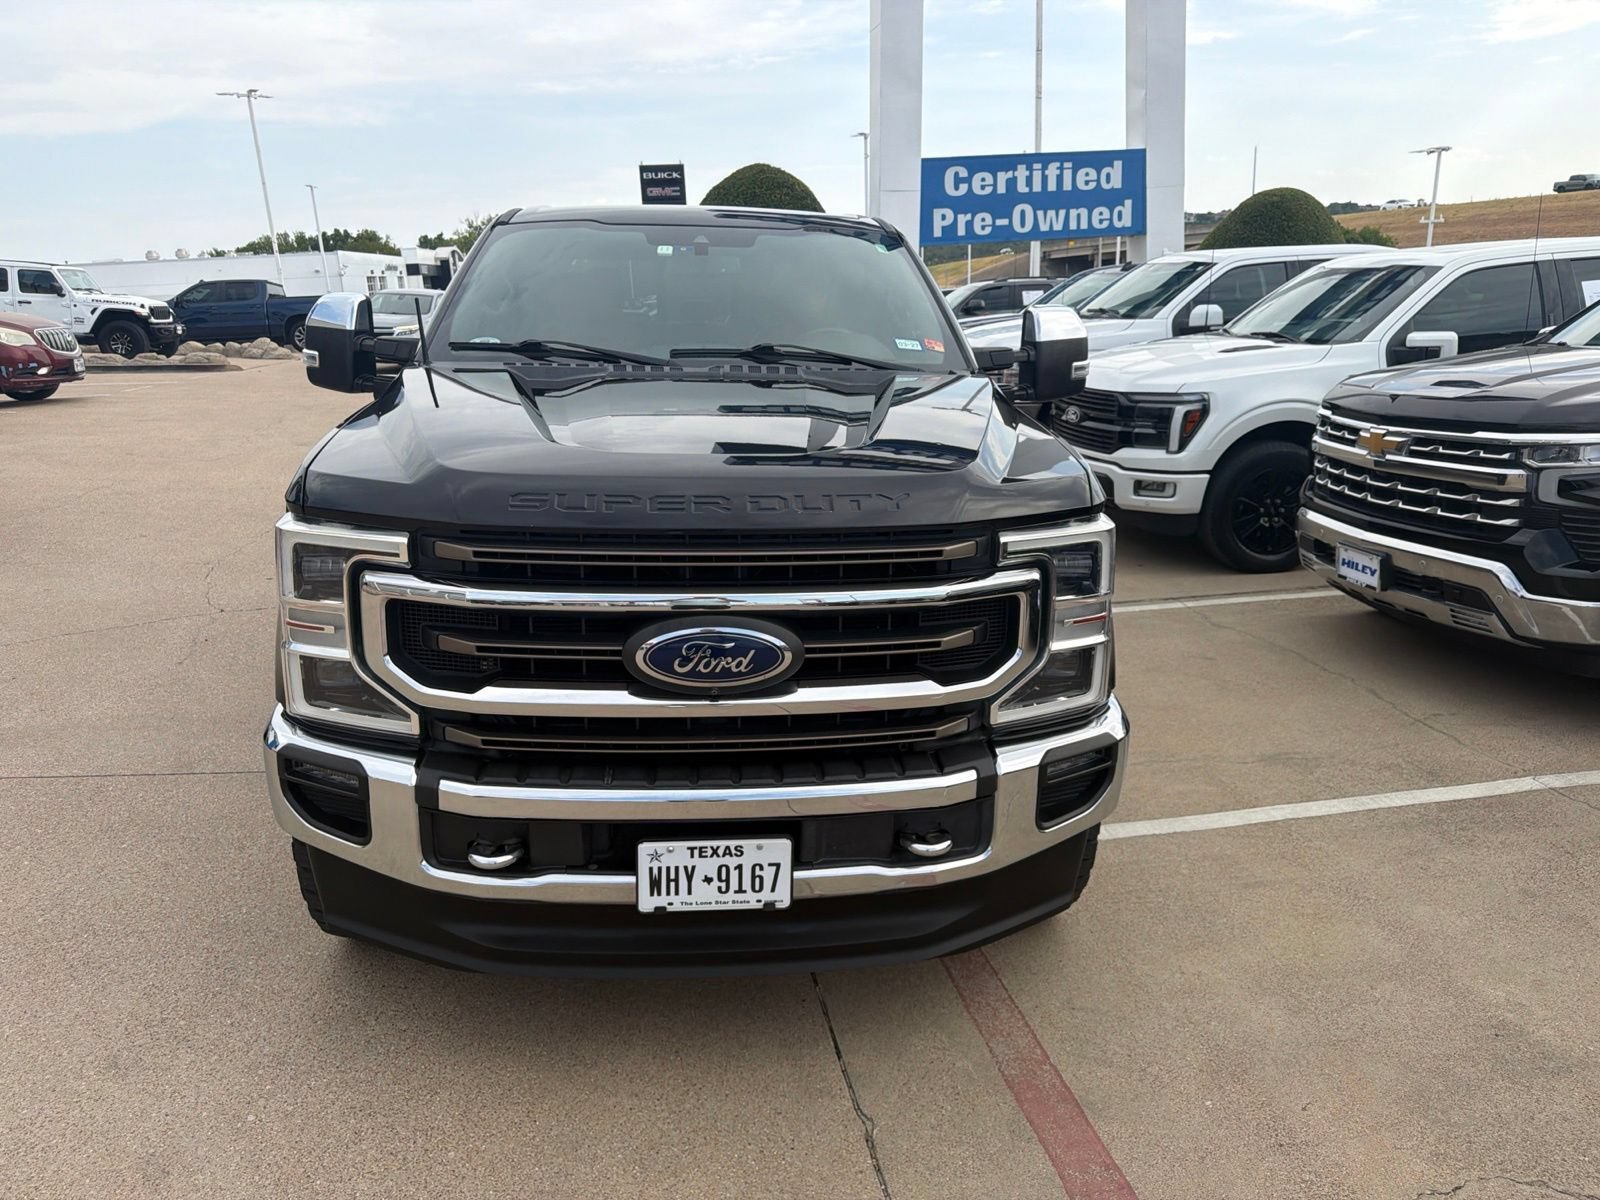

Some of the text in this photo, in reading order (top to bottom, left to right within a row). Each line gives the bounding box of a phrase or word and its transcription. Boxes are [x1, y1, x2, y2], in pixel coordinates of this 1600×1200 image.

[642, 171, 681, 180] BUICK
[944, 160, 1123, 197] Certified
[646, 187, 681, 197] GMC
[932, 199, 1133, 238] Pre-Owned
[91, 298, 137, 306] RUBICON
[508, 492, 911, 514] SUPER DUTY
[1341, 557, 1378, 577] HILEY
[673, 640, 755, 673] Ford
[687, 845, 744, 859] TEXAS
[648, 862, 782, 897] WHY 9167
